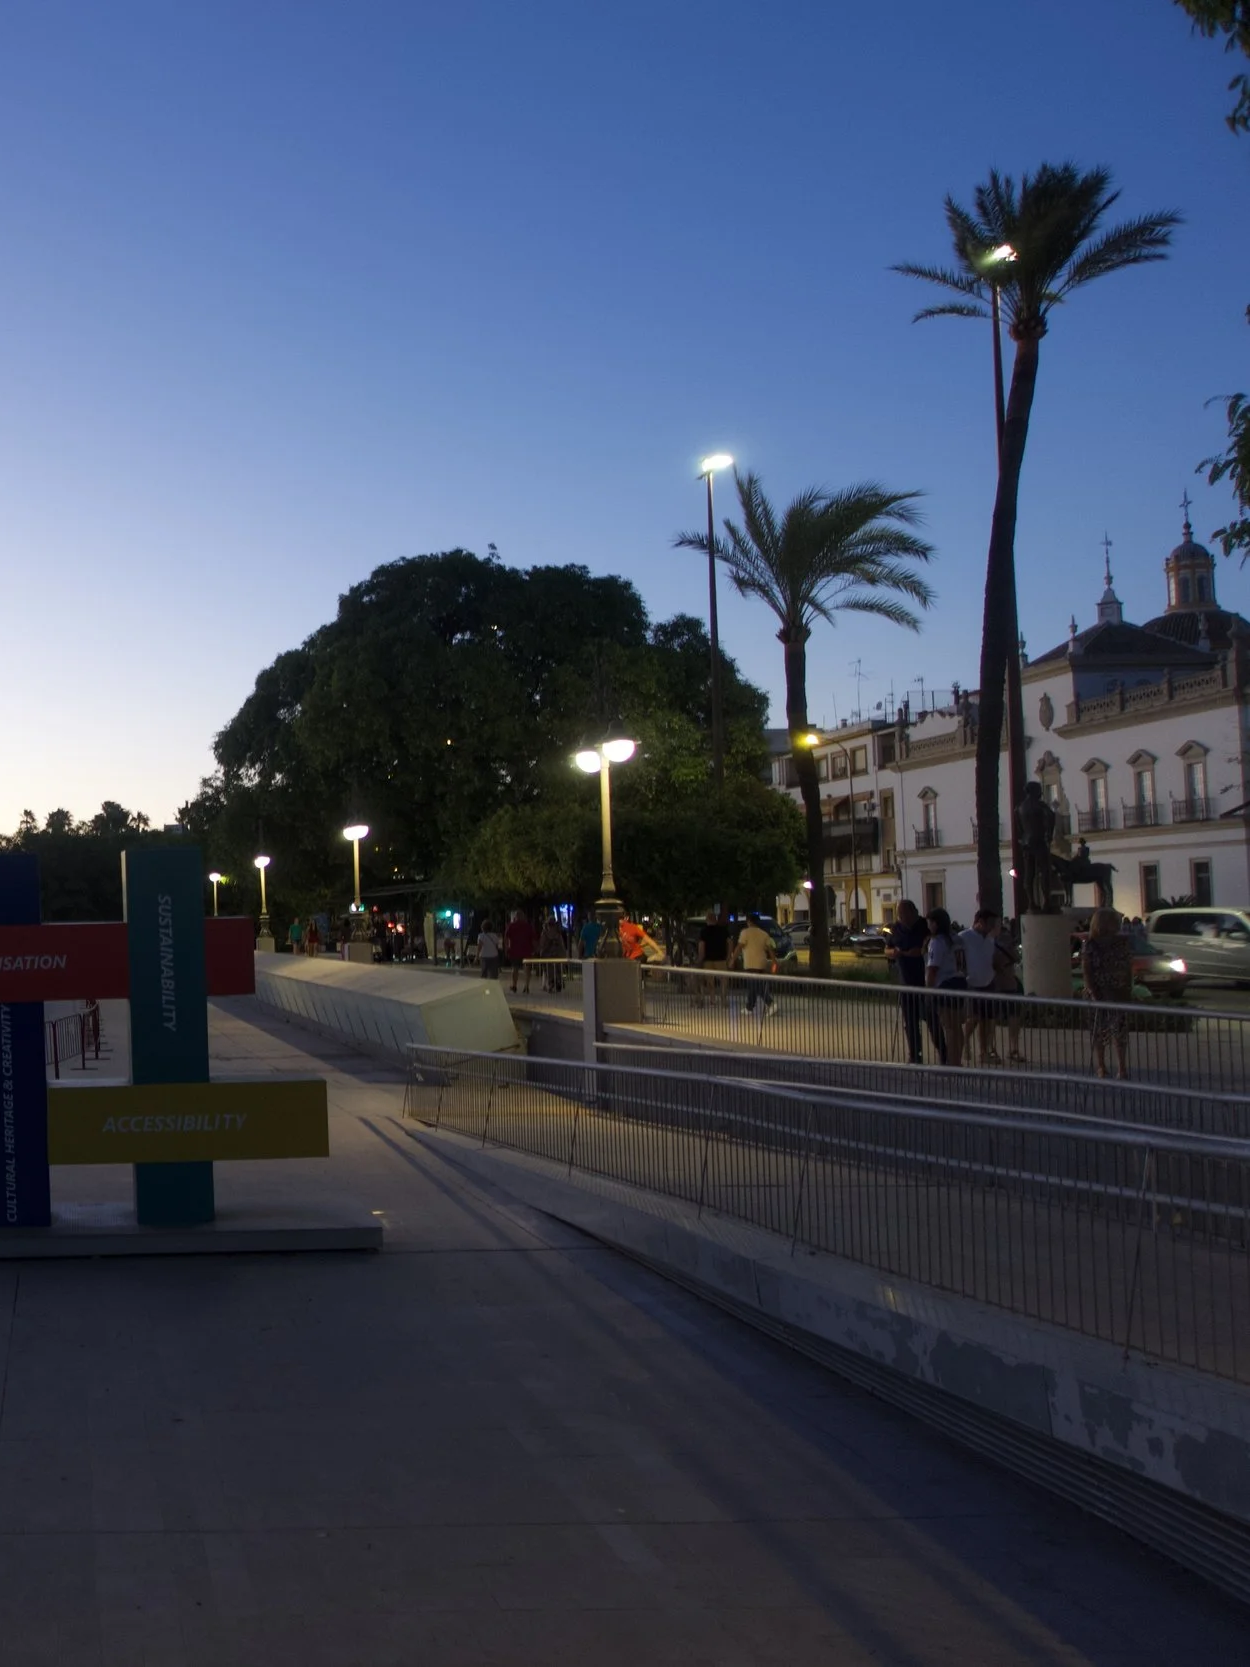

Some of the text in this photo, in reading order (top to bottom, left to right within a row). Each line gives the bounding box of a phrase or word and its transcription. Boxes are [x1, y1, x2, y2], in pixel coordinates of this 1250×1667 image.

[158, 893, 178, 1032] SUSTAINABILITY
[0, 1003, 18, 1222] CULTURAL HERITAGE & CREATIVITY
[102, 1112, 248, 1134] ACCESSIBILITY
